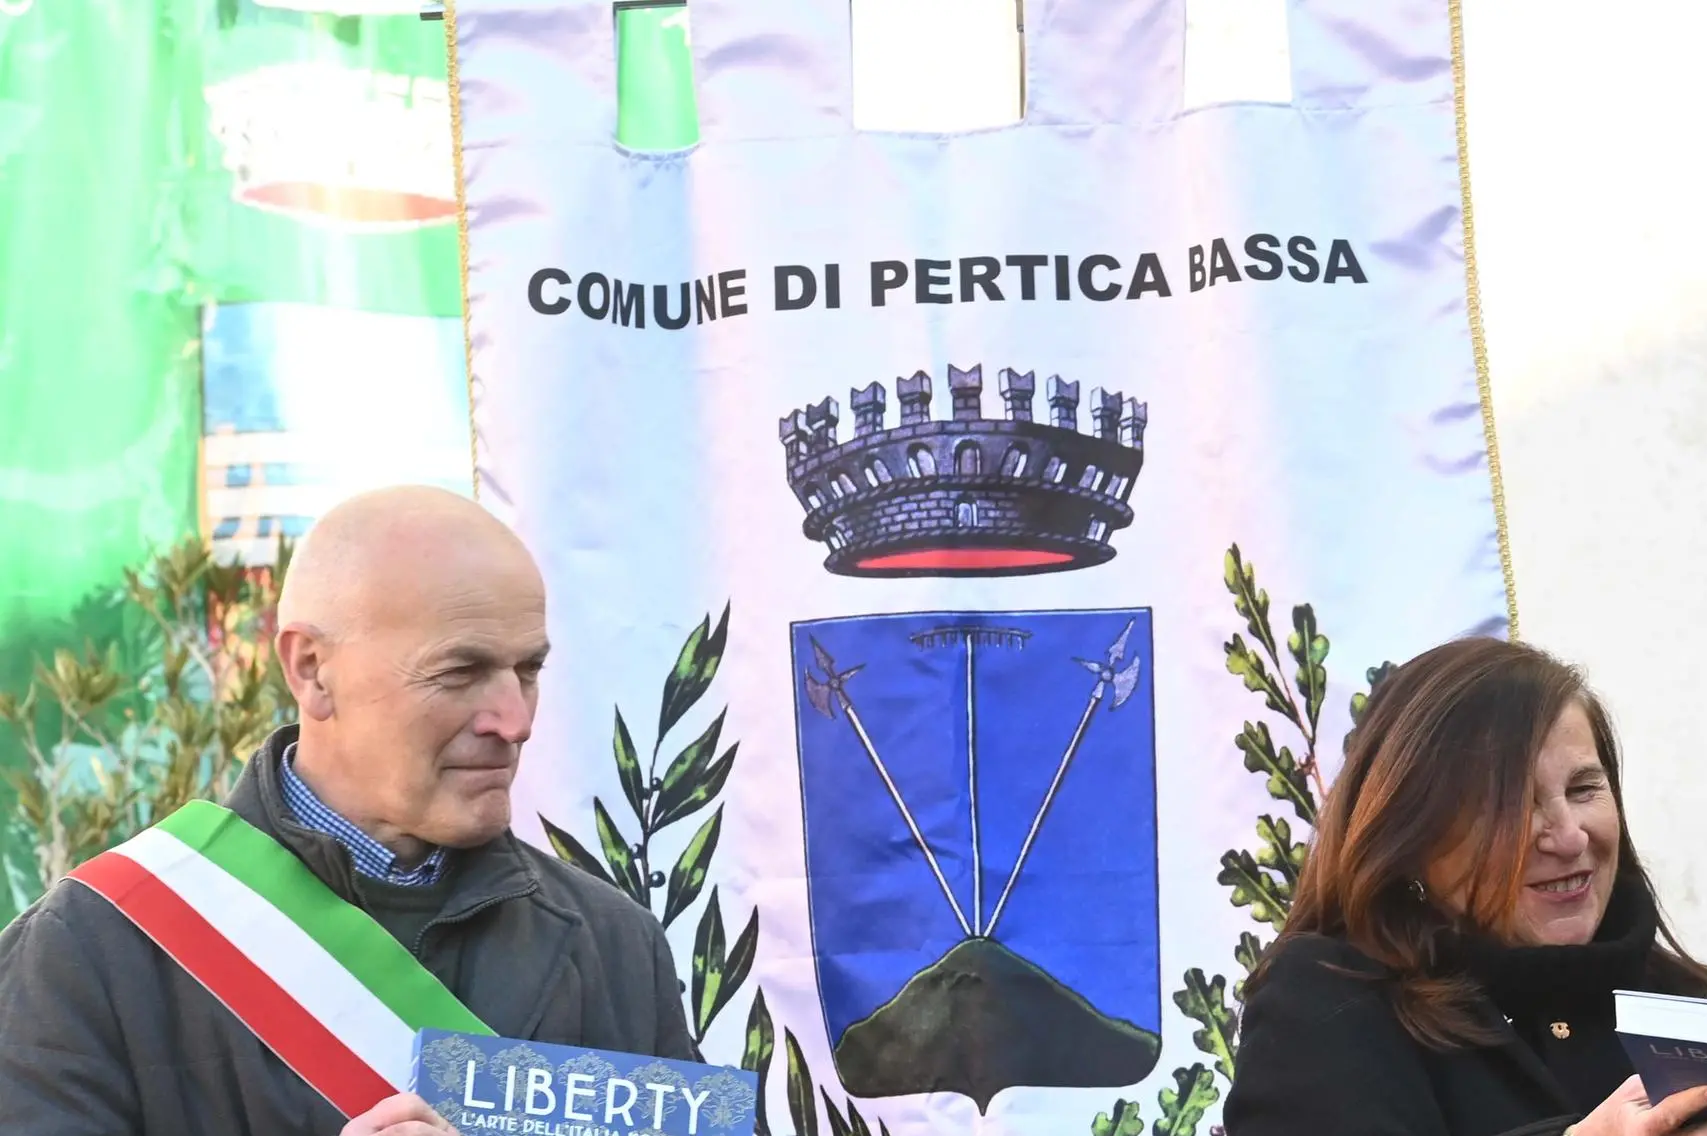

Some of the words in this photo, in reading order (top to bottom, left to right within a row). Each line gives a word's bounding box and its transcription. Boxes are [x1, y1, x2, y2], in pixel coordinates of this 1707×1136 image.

[527, 267, 749, 331] COMUNE
[774, 262, 841, 312] DI
[870, 252, 1173, 308] PERTICA
[1187, 232, 1369, 294] BASSA
[461, 1111, 518, 1132] L'ARTE
[463, 1060, 711, 1135] LIBERTY
